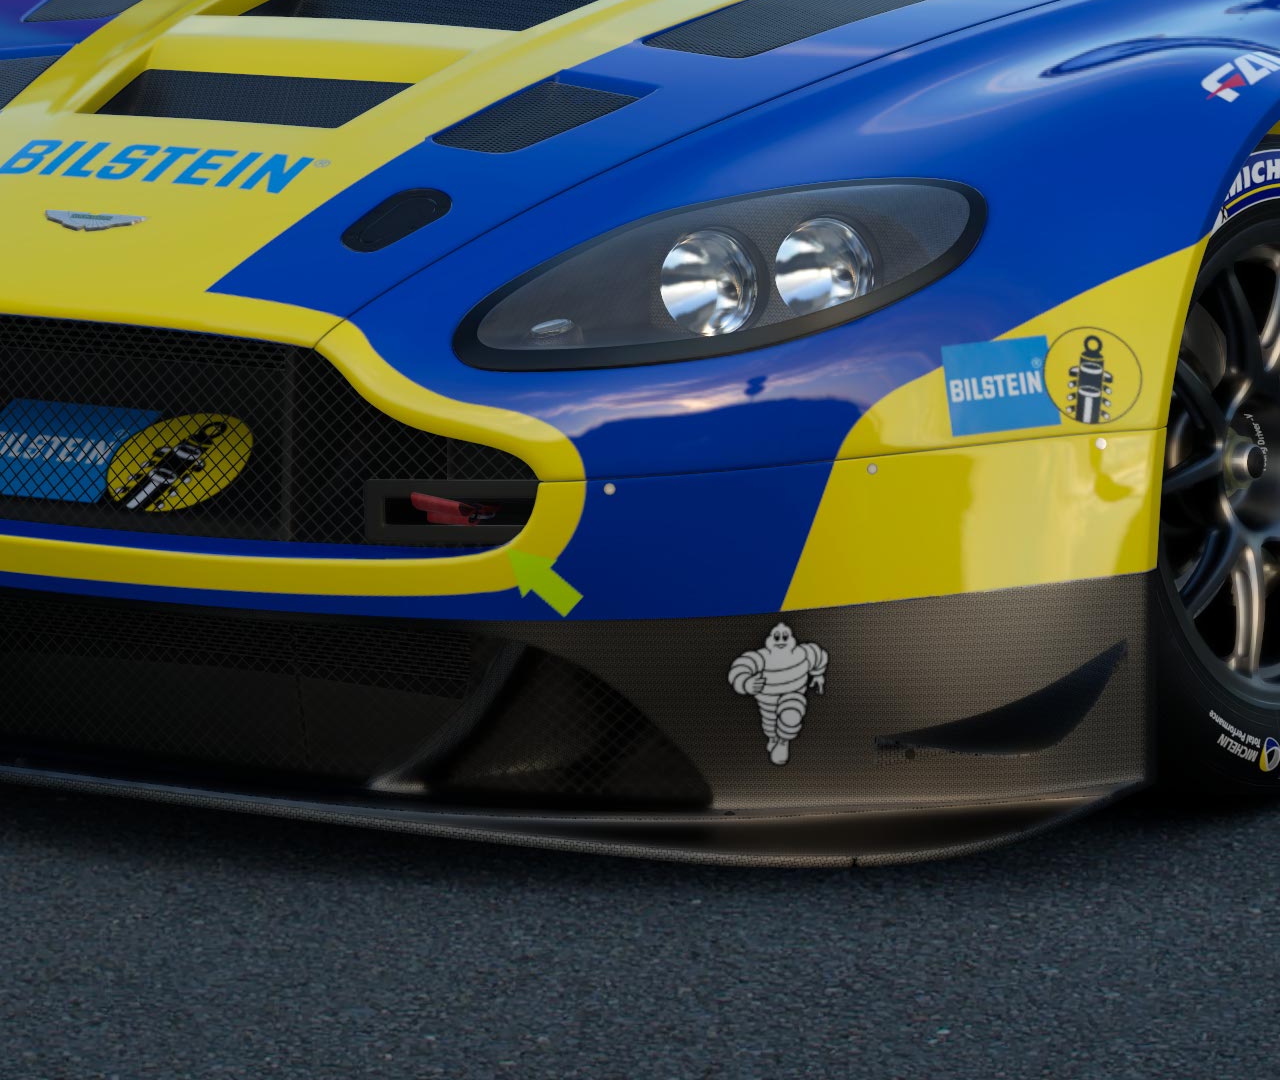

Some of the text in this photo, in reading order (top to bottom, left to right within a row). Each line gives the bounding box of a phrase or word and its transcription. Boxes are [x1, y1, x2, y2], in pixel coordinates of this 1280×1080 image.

[949, 370, 1043, 403] BILSTEIN
[1208, 710, 1261, 747] Total Performance
[1216, 733, 1259, 763] MICHELIN
